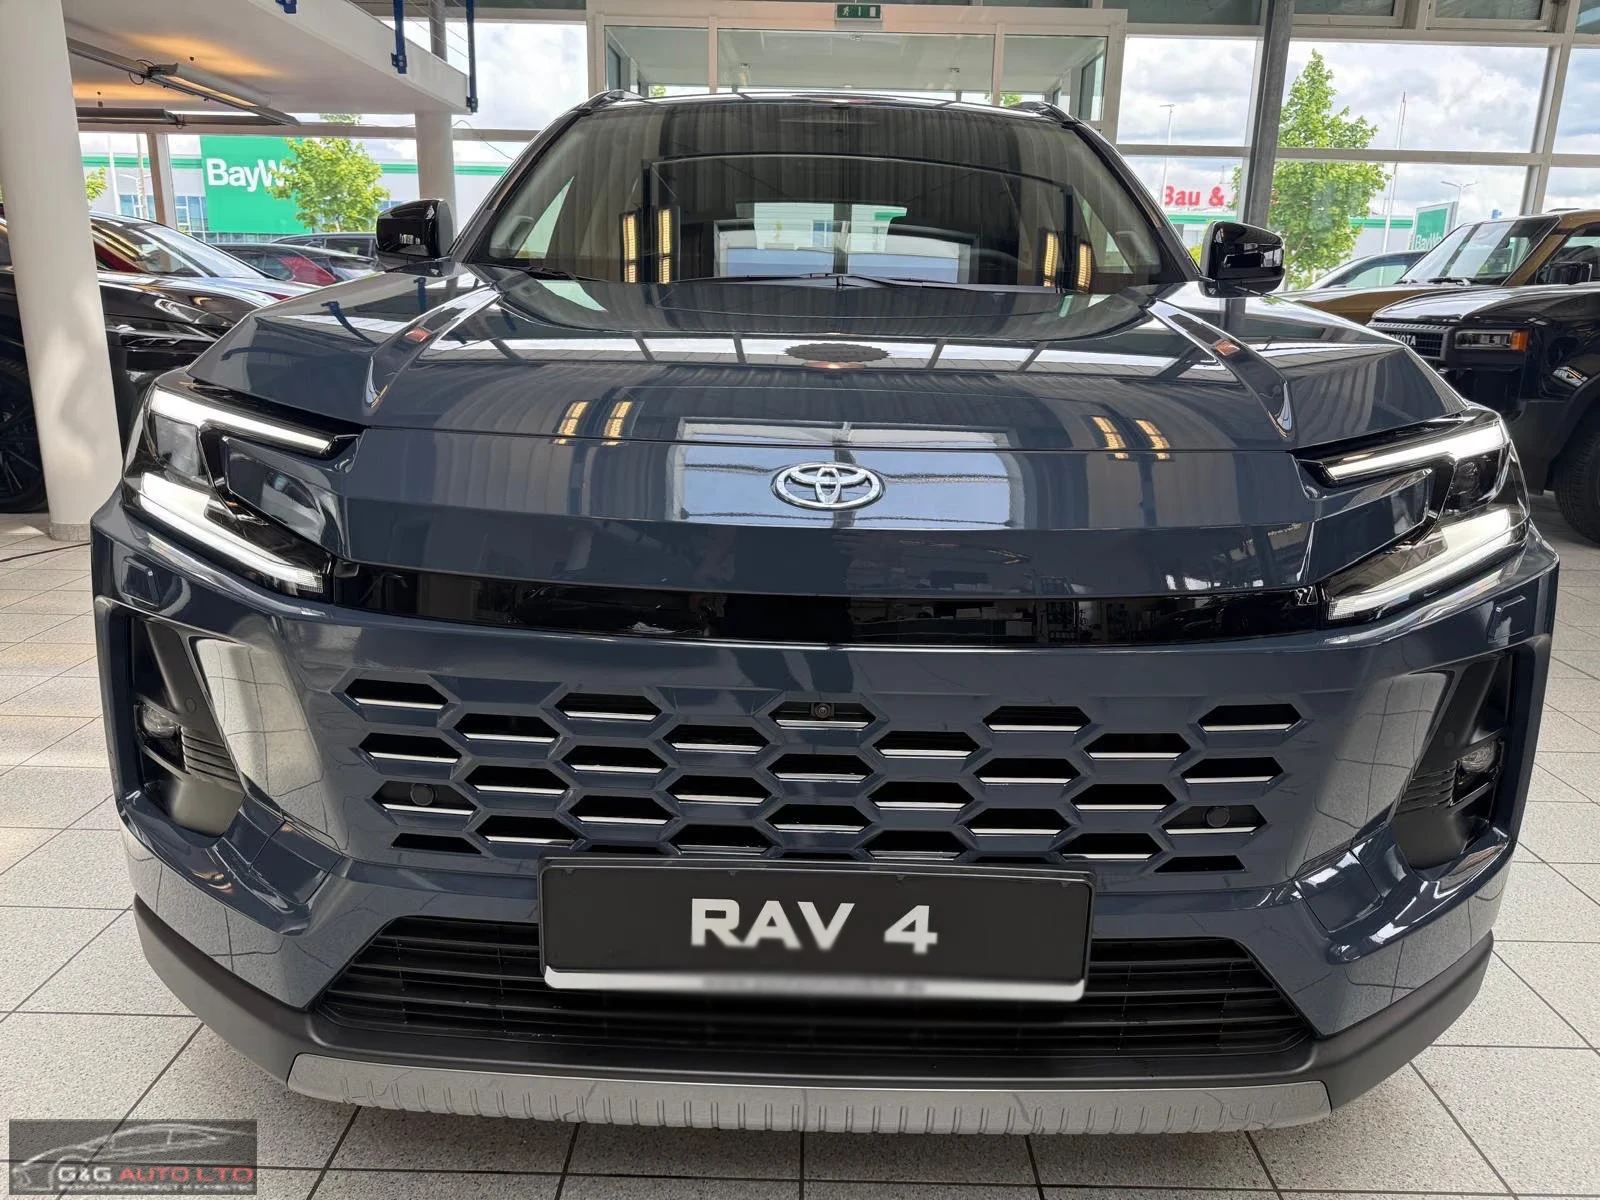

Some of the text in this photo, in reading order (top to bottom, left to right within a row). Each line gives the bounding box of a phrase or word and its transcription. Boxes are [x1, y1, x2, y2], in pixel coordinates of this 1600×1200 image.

[1208, 185, 1225, 207] &
[691, 898, 939, 955] RAV 4
